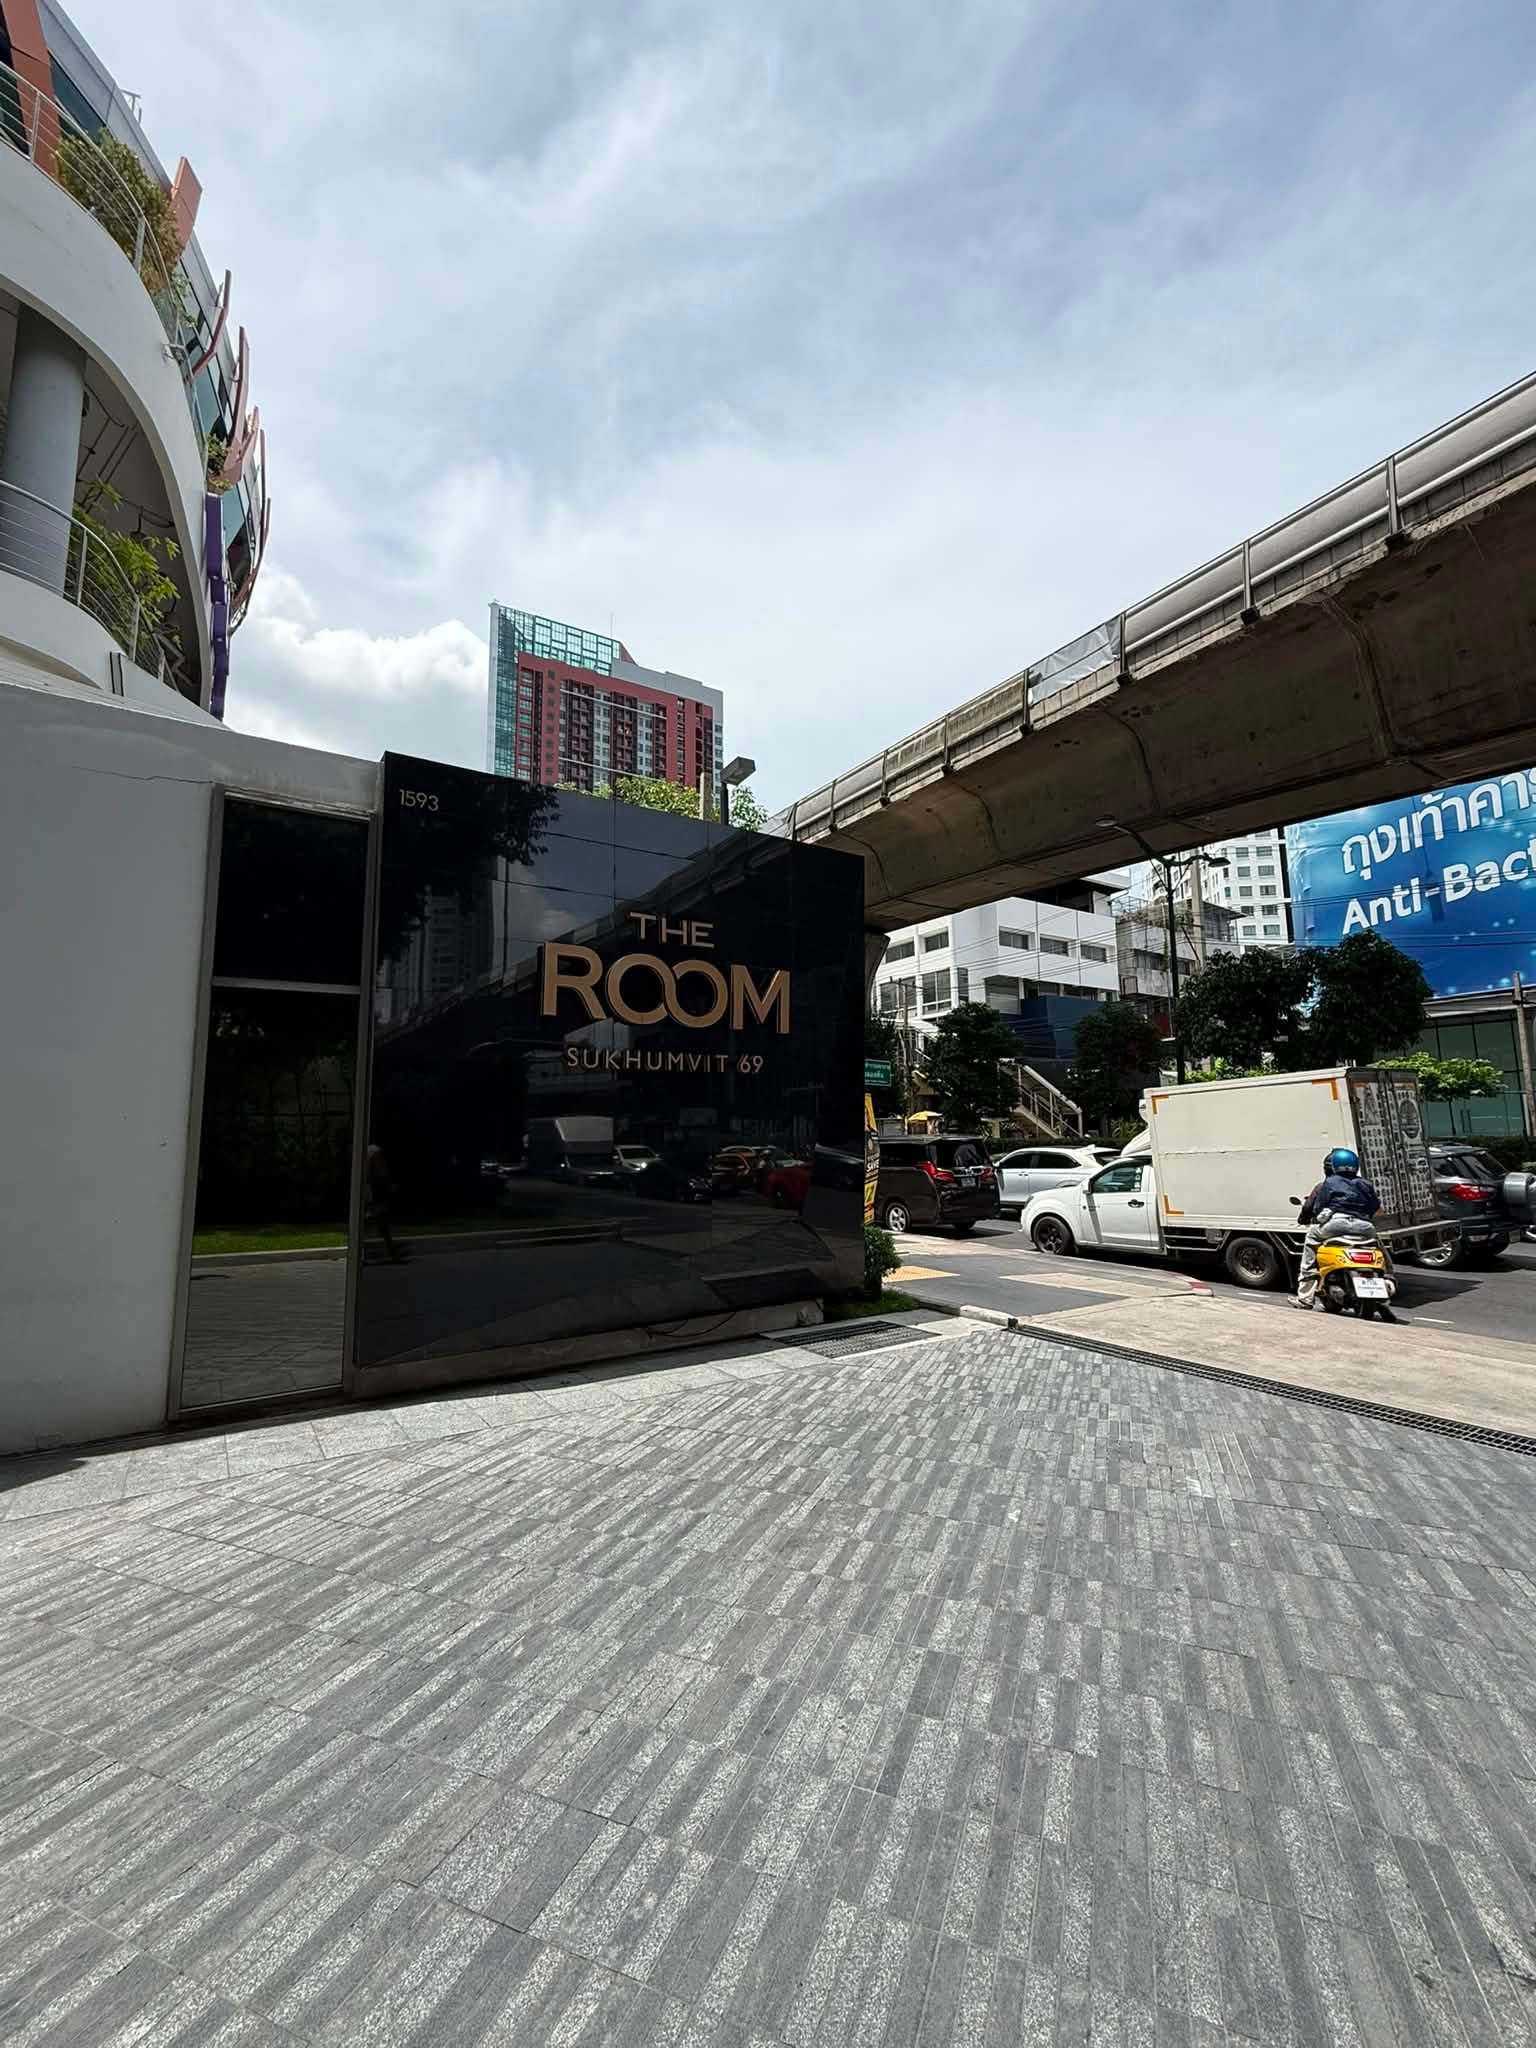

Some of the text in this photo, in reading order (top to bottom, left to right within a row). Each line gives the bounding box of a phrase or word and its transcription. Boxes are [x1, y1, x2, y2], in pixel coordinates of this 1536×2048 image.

[399, 788, 439, 812] 1593
[630, 912, 715, 948] THE
[541, 943, 791, 1035] ROOM
[567, 1047, 764, 1074] SUKHUMVIT 69
